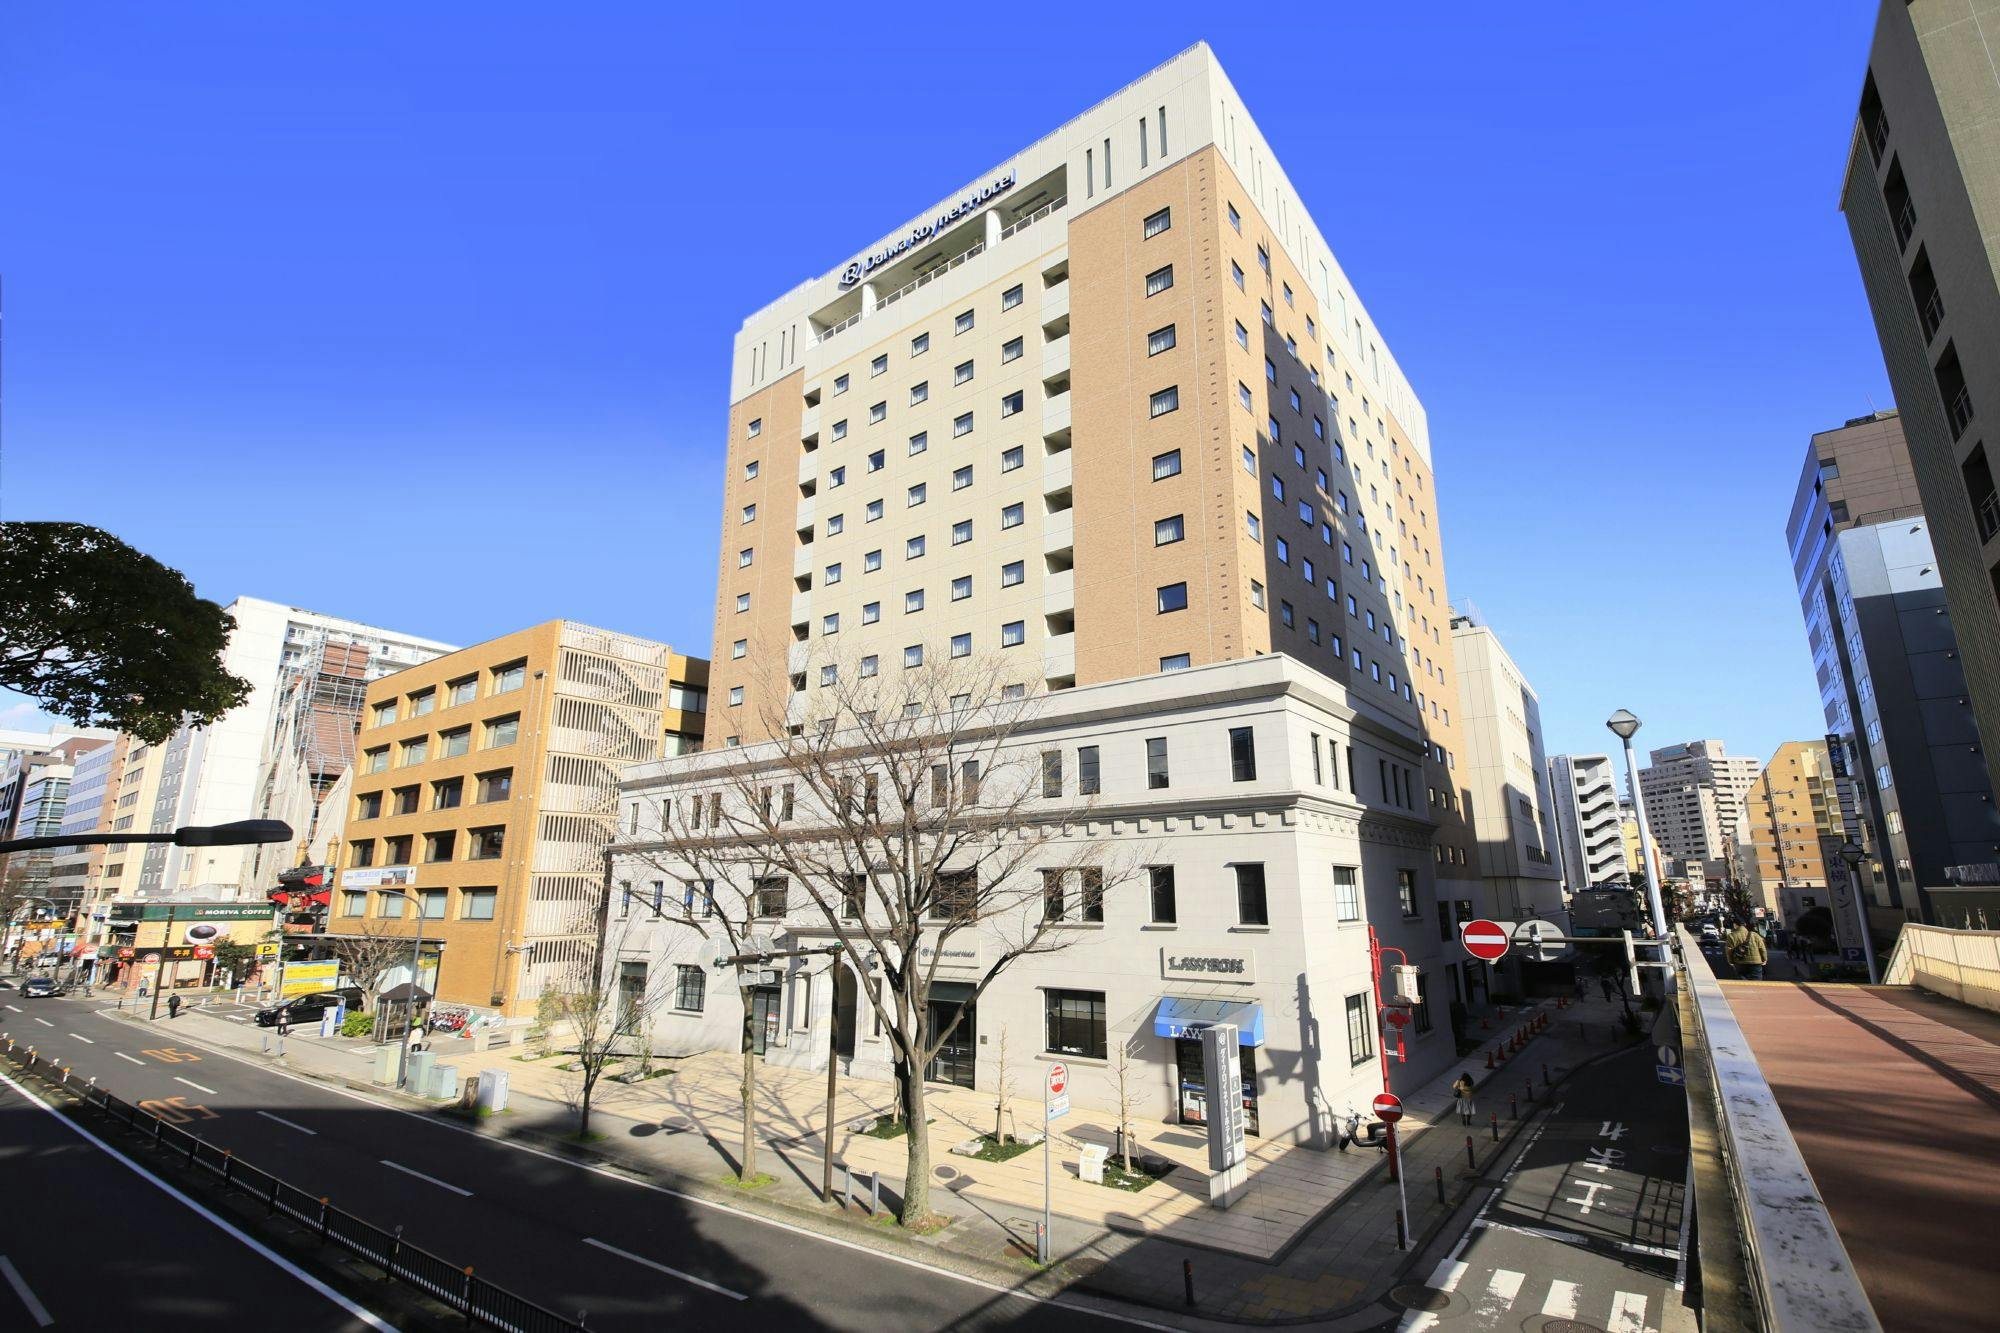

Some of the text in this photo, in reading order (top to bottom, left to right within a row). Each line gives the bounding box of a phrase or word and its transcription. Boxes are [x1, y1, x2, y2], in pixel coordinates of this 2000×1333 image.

[864, 167, 1016, 273] Daiwa Roynet Hotel
[262, 945, 272, 954] P
[1847, 949, 1860, 960] P
[1168, 956, 1245, 974] LAWSON
[1169, 1025, 1203, 1040] LAW
[141, 1048, 202, 1064] 50
[1226, 1151, 1233, 1166] P
[1565, 1120, 1629, 1214] 止まれ
